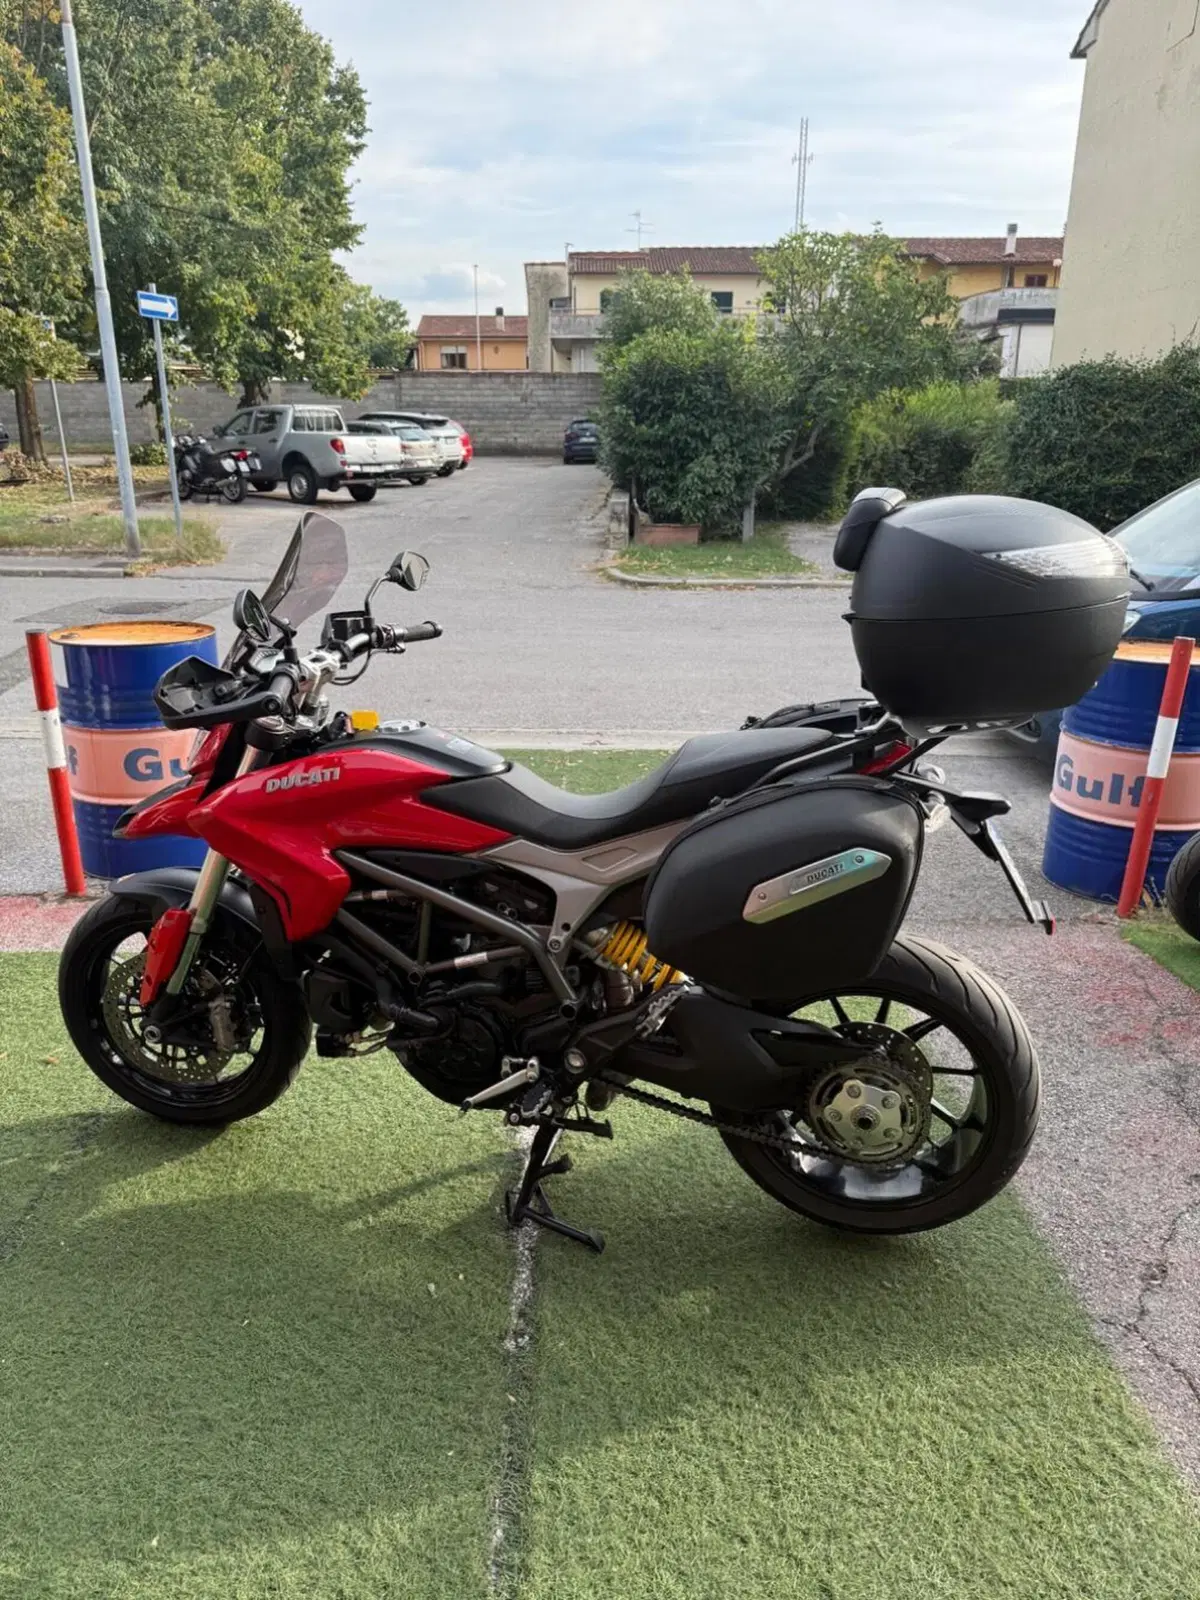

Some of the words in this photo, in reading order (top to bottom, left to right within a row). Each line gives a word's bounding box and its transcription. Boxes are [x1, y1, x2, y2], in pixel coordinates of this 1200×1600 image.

[265, 766, 341, 793] DUCATI
[1056, 754, 1148, 808] Gulf
[806, 864, 844, 882] DUCATI
